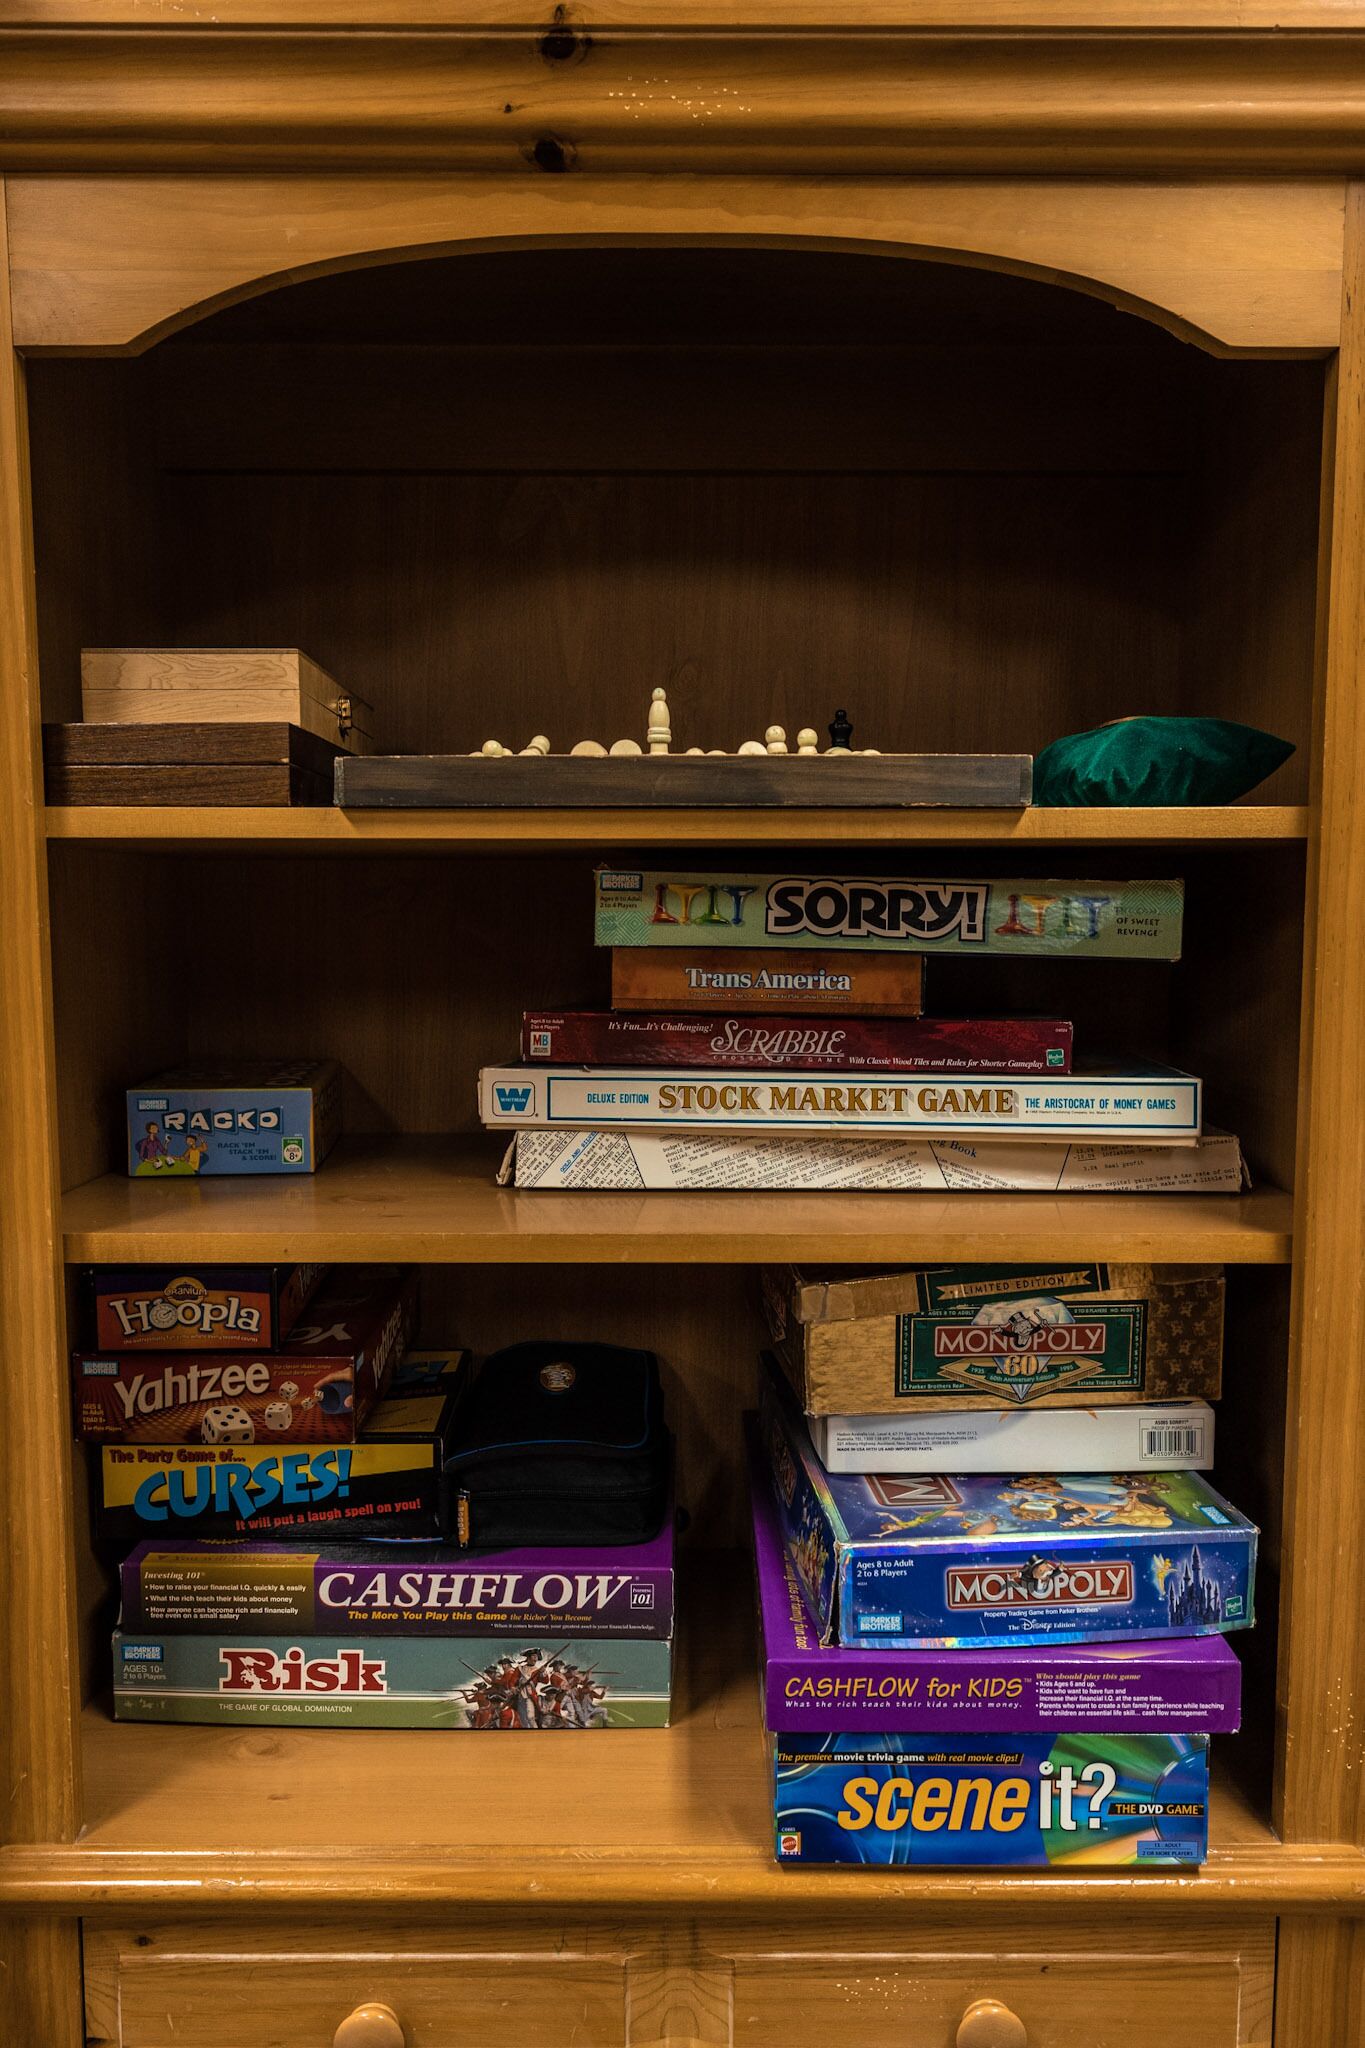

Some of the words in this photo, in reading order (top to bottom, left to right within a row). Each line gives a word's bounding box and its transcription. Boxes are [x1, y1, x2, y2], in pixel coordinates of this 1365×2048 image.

[768, 879, 991, 943] SORRY!
[1116, 917, 1128, 925] OF
[1131, 918, 1160, 926] SWEET
[1117, 928, 1158, 936] REVENGE
[533, 1034, 548, 1046] MB
[710, 1019, 847, 1062] SCRABBLE
[587, 1093, 616, 1103] DELUXE
[619, 1094, 649, 1104] EDITION
[658, 1085, 761, 1110] STOCK
[768, 1086, 909, 1113] MARKET
[917, 1088, 1015, 1114] GAME
[1025, 1098, 1040, 1108] THE
[1045, 1098, 1095, 1109] ARISTOCRAT
[1099, 1099, 1109, 1109] OF
[1113, 1099, 1143, 1110] MONEY
[1147, 1099, 1176, 1110] GAMES
[163, 1110, 279, 1131] RACKO
[950, 1140, 977, 1158] Book
[963, 1282, 1010, 1294] LIMITED
[1016, 1276, 1064, 1289] EDITION
[109, 1295, 260, 1335] Hoopla
[938, 1328, 1103, 1353] MONOPOLY
[1003, 1355, 1039, 1377] 60
[113, 1362, 271, 1420] Yahtzee
[109, 1449, 134, 1463] The
[137, 1449, 173, 1466] Party
[177, 1449, 215, 1463] Game
[218, 1448, 246, 1463] of...
[133, 1448, 353, 1521] CURSES!
[235, 1519, 246, 1531] It
[248, 1516, 271, 1531] will
[273, 1514, 295, 1528] put
[296, 1515, 305, 1525] a
[307, 1507, 342, 1526] laugh
[344, 1503, 374, 1523] spell
[376, 1504, 392, 1516] on
[394, 1498, 421, 1516] you!
[856, 1560, 875, 1570] Ages
[876, 1560, 882, 1568] 8
[884, 1560, 892, 1568] to
[893, 1559, 914, 1568] Adult
[144, 1571, 184, 1581] Investing
[186, 1571, 201, 1580] 101
[856, 1570, 862, 1578] 2
[863, 1570, 873, 1578] to
[881, 1569, 907, 1578] Players
[318, 1573, 633, 1610] CASHFLOW
[953, 1568, 1125, 1603] MONOPOLY
[249, 1595, 268, 1603] about
[270, 1596, 293, 1604] money
[264, 1607, 298, 1615] financially
[348, 1610, 369, 1620] The
[371, 1611, 399, 1620] More
[402, 1611, 423, 1620] You
[425, 1611, 449, 1622] Play
[451, 1611, 473, 1621] this
[475, 1611, 507, 1621] Game
[510, 1613, 522, 1621] the
[523, 1613, 547, 1622] Richer
[550, 1614, 564, 1622] You
[565, 1614, 593, 1622] Become
[984, 1610, 1007, 1618] Property
[1008, 1610, 1027, 1618] Trading
[1028, 1609, 1044, 1617] Game
[1045, 1608, 1058, 1616] from
[1059, 1607, 1075, 1615] Parker
[871, 1616, 900, 1624] PARKER
[860, 1623, 901, 1631] BROTHERS
[123, 1665, 148, 1673] AGES
[219, 1648, 387, 1693] Risk
[784, 1677, 919, 1698] CASHFLOW
[926, 1677, 961, 1698] for
[967, 1677, 1024, 1698] KIDS
[219, 1703, 234, 1711] THE
[235, 1703, 257, 1711] GAME
[271, 1704, 303, 1712] GLOBAL
[304, 1704, 353, 1713] DOMINATION
[785, 1700, 811, 1708] What
[815, 1700, 833, 1708] the
[837, 1700, 857, 1708] rich
[862, 1700, 891, 1708] teach
[896, 1700, 922, 1708] their
[926, 1700, 948, 1708] kids
[987, 1702, 1023, 1710] money.
[778, 1753, 794, 1762] The
[795, 1753, 832, 1763] premiere
[834, 1753, 865, 1762] movie
[866, 1753, 894, 1762] trivia
[896, 1754, 925, 1763] game
[927, 1753, 947, 1762] with
[948, 1754, 966, 1762] real
[967, 1754, 994, 1763] movie
[995, 1753, 1018, 1764] clips!
[836, 1776, 1031, 1832] scene
[1038, 1760, 1117, 1832] it?
[1115, 1804, 1137, 1814] THE
[1138, 1803, 1164, 1815] DVD
[1166, 1804, 1199, 1815] GAME
